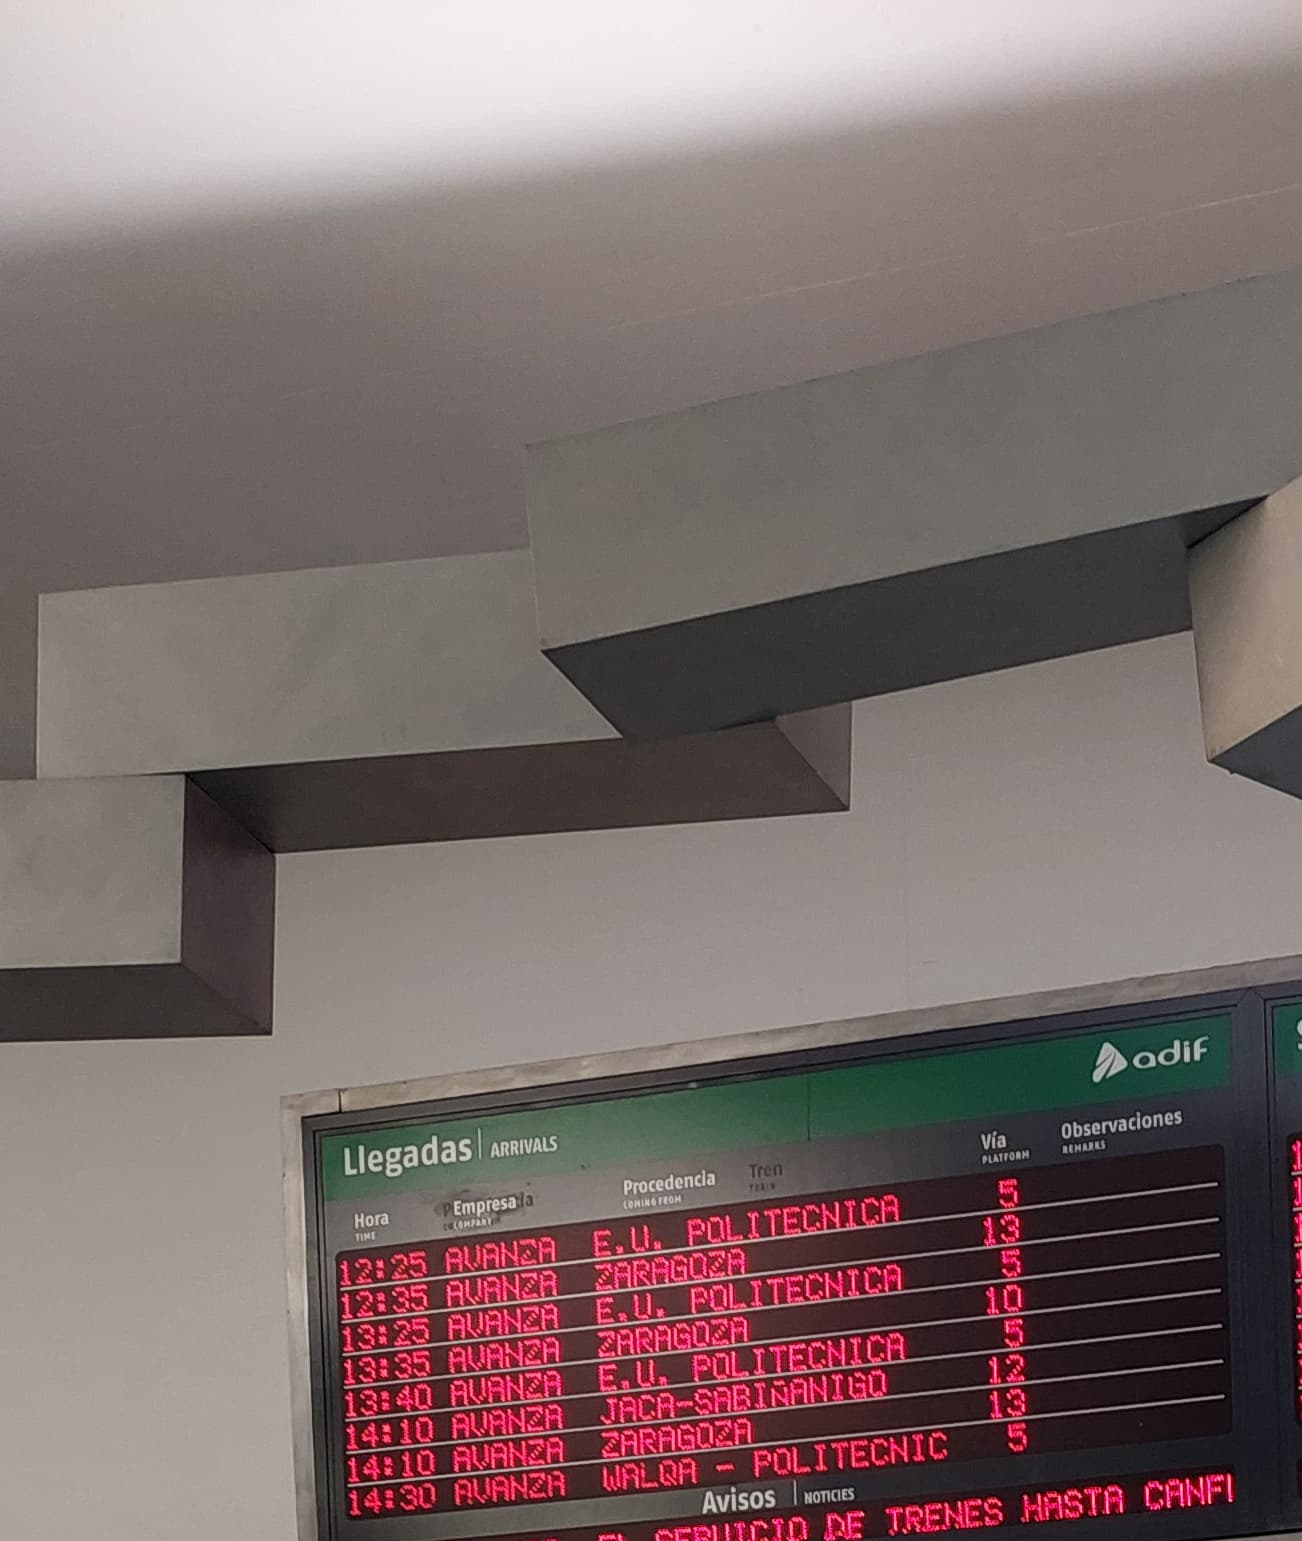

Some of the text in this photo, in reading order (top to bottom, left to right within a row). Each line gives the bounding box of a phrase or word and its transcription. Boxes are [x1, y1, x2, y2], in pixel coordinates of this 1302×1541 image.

[1132, 1036, 1210, 1069] adif
[980, 1131, 1008, 1152] Vía
[1060, 1109, 1184, 1140] Observaciones
[1062, 1139, 1107, 1154] REMARKS
[343, 1130, 559, 1179] Llegadas ARRIVALS
[982, 1149, 1031, 1165] PLATFORM
[453, 1196, 517, 1218] Empresa
[622, 1170, 717, 1195] Procedencia
[339, 1178, 1019, 1287] 12:25 AVANZA E.U. POLITECNICA 5
[353, 1209, 390, 1229] Hora
[340, 1213, 1021, 1321] 12:35 AVANZA ZARAGOZA 13
[342, 1247, 1023, 1354] 13:25 AVANZA E.U. POLITECNICA 5
[343, 1283, 1025, 1387] 13:35 AVANZA ZARAGOZA 10
[344, 1317, 1025, 1419] 13:40 AVANZA E.U. POLITECNICA 5
[345, 1415, 435, 1452] 14:10
[450, 1402, 566, 1441] AVANZA
[988, 1352, 1026, 1386] 12
[347, 1387, 1027, 1484] 14:10 AVANZA ZARAGOZA 13
[348, 1482, 437, 1516] 14:30
[453, 1469, 567, 1505] AVANZA
[601, 1456, 700, 1492] WALQA
[752, 1430, 948, 1478] POLITECNIC
[1006, 1422, 1028, 1453] 5
[701, 1485, 856, 1517] Avisos NOTICIES
[884, 1496, 1004, 1536] TRENES
[1020, 1484, 1125, 1523] HASTA
[1143, 1473, 1235, 1511] CANF
